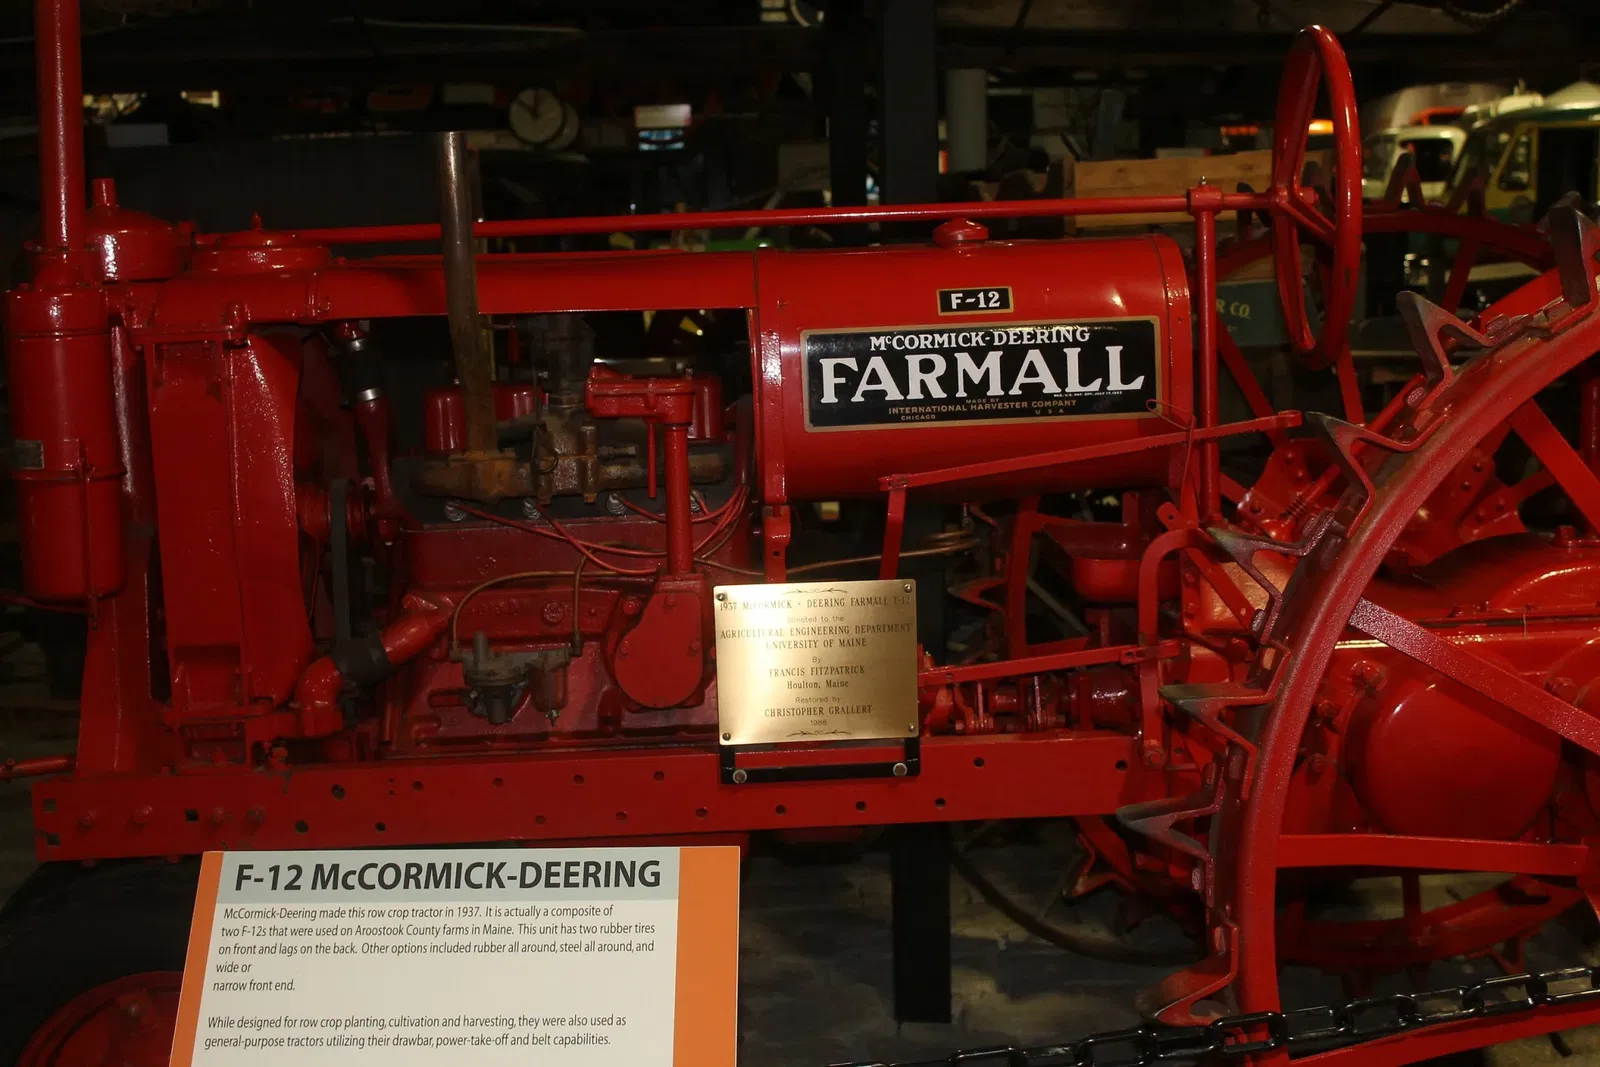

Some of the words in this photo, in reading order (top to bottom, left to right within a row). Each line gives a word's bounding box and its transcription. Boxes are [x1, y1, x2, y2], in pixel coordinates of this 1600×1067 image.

[950, 291, 1001, 310] F-12
[870, 326, 1090, 352] McCORMICK-DEERING
[820, 346, 1146, 404] FARMALL
[888, 405, 967, 415] INTERNATIONAL
[970, 402, 1028, 410] HARVESTER
[1031, 400, 1077, 408] COMPANY
[807, 598, 845, 608] DEERING
[850, 596, 889, 607] FARMALL
[720, 627, 785, 639] AGRICULTURAL
[790, 625, 850, 637] ENGINEERING
[855, 623, 912, 634] DEPARTMENT
[766, 639, 819, 649] UNIVERSITY
[823, 639, 834, 648] OF
[839, 638, 867, 647] MAINE
[812, 656, 822, 664] By
[769, 668, 805, 678] FRANCIS
[810, 665, 865, 676] FITZPATRICK
[787, 680, 821, 689] Houlton,
[825, 680, 849, 688] Maine
[832, 696, 842, 704] by
[764, 707, 824, 717] CHRISTOPHER
[829, 705, 872, 715] GRALLERT
[234, 863, 302, 890] F-12
[310, 860, 660, 890] McCORMICK-DEERING
[223, 907, 317, 921] McCormick-Deering
[318, 906, 346, 918] made
[348, 906, 365, 918] this
[367, 909, 386, 918] row
[387, 909, 409, 920] crop
[411, 907, 443, 917] tractor
[444, 906, 453, 917] in
[457, 906, 481, 917] 1937.
[485, 906, 492, 916] It
[494, 905, 501, 917] is
[503, 904, 541, 919] actually
[542, 907, 548, 916] a
[550, 904, 601, 918] composite
[602, 904, 613, 916] of
[221, 926, 239, 937] two
[241, 925, 266, 936] F-12s
[268, 924, 288, 936] that
[290, 927, 313, 936] were
[315, 924, 338, 936] used
[340, 927, 352, 935] on
[354, 923, 403, 935] Aroostook
[405, 923, 441, 938] County
[442, 923, 469, 935] farms
[471, 923, 480, 934] in
[482, 923, 514, 934] Maine.
[517, 923, 536, 934] This
[539, 923, 558, 934] unit
[560, 922, 576, 934] has
[579, 924, 597, 934] two
[599, 921, 632, 933] rubber
[634, 922, 655, 933] tires
[218, 945, 231, 954] on
[232, 942, 256, 954] front
[258, 942, 277, 954] and
[278, 942, 298, 957] lags
[299, 945, 312, 954] on
[314, 942, 331, 954] the
[332, 942, 357, 954] back.
[361, 941, 389, 954] Other
[390, 942, 427, 956] options
[429, 941, 471, 953] included
[473, 941, 506, 953] rubber
[508, 940, 519, 952] all
[521, 940, 557, 953] around,
[559, 940, 582, 952] steel
[584, 940, 595, 951] all
[597, 940, 634, 952] around,
[635, 939, 654, 951] and
[215, 961, 239, 972] wide
[240, 963, 252, 972] or
[212, 982, 247, 991] narrow
[248, 978, 273, 990] front
[274, 978, 295, 990] end.
[207, 1015, 235, 1028] While
[236, 1015, 282, 1031] designed
[283, 1015, 298, 1028] for
[299, 1018, 318, 1027] row
[320, 1018, 342, 1030] crop
[343, 1015, 386, 1030] planting,
[388, 1015, 439, 1027] cultivation
[441, 1014, 460, 1026] and
[462, 1014, 516, 1029] harvesting,
[518, 1014, 540, 1029] they
[542, 1017, 566, 1026] were
[568, 1014, 587, 1026] also
[590, 1013, 613, 1026] used
[615, 1016, 626, 1025] as
[204, 1034, 284, 1050] general-purpose
[287, 1036, 324, 1046] tractors
[326, 1034, 365, 1049] utilizing
[367, 1034, 390, 1046] their
[392, 1033, 434, 1047] drawbar,
[435, 1032, 509, 1048] power-take-off
[510, 1033, 529, 1045] and
[531, 1032, 550, 1045] belt
[553, 1032, 610, 1047] capabilities.
